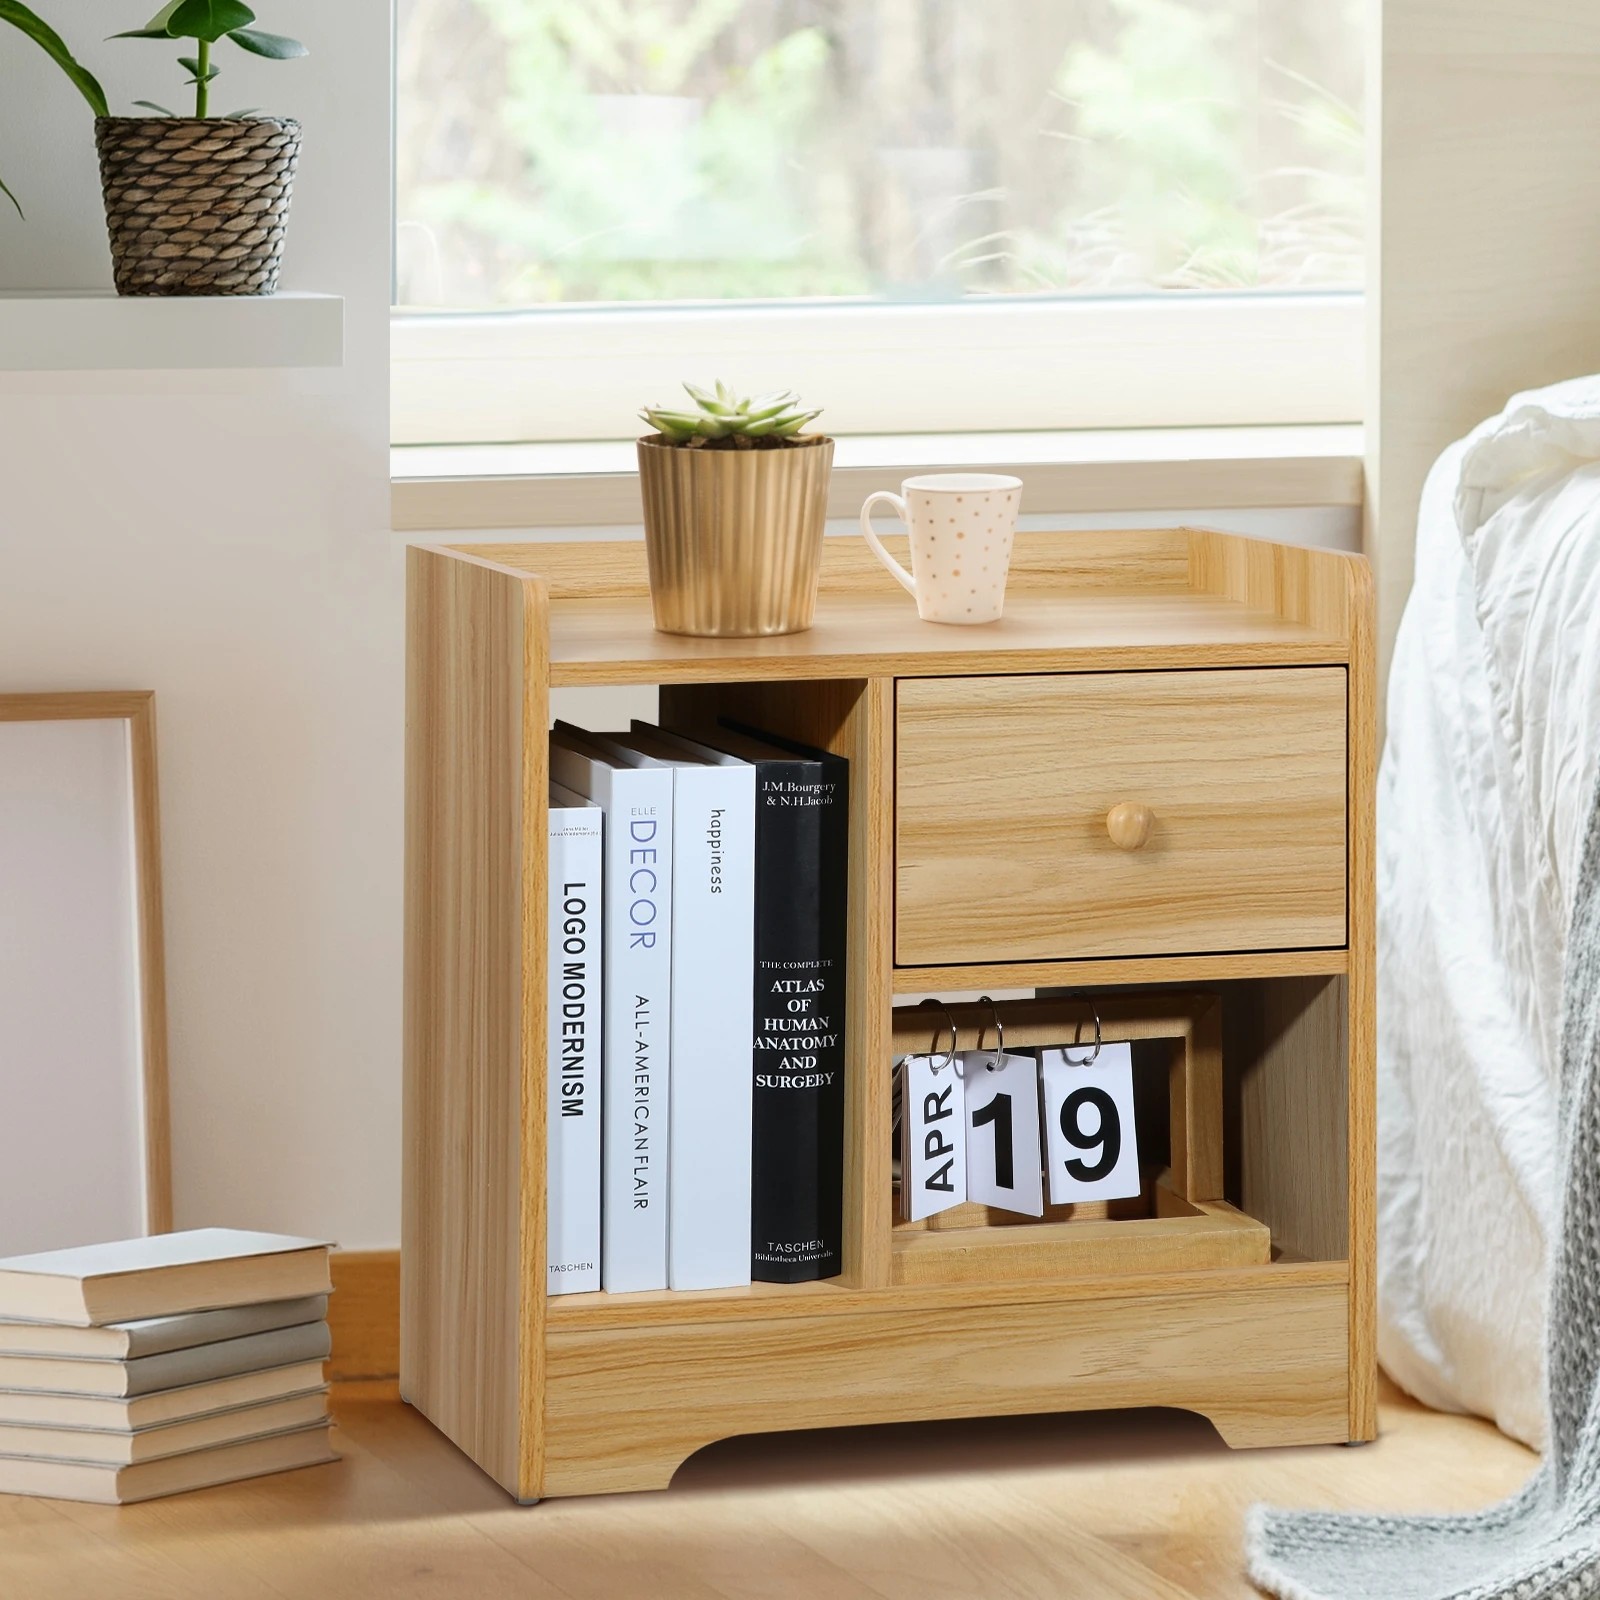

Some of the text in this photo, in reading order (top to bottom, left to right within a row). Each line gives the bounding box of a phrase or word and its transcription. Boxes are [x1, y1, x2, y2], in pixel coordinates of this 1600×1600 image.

[762, 781, 836, 794] J.M.Bourgery
[766, 795, 776, 806] &
[631, 807, 657, 816] ELLE
[707, 809, 726, 894] happiness
[629, 820, 657, 949] DECOR
[759, 960, 833, 970] THE COMPLETE
[771, 979, 825, 993] ATLAS
[561, 883, 586, 1117] LOGO MODERNISM
[787, 999, 812, 1013] OF
[764, 1016, 830, 1031] HUMAN
[753, 1034, 838, 1050] ANATOMY
[778, 1056, 817, 1070] AND
[633, 995, 650, 1210] ALL-AMERICAN FLAIR
[923, 1084, 954, 1192] APR
[972, 1086, 1121, 1190] 1 9
[767, 1240, 824, 1253] TASCHEN
[755, 1250, 834, 1262] Bibliotheca Universalis
[549, 1262, 593, 1273] TASCHEN
